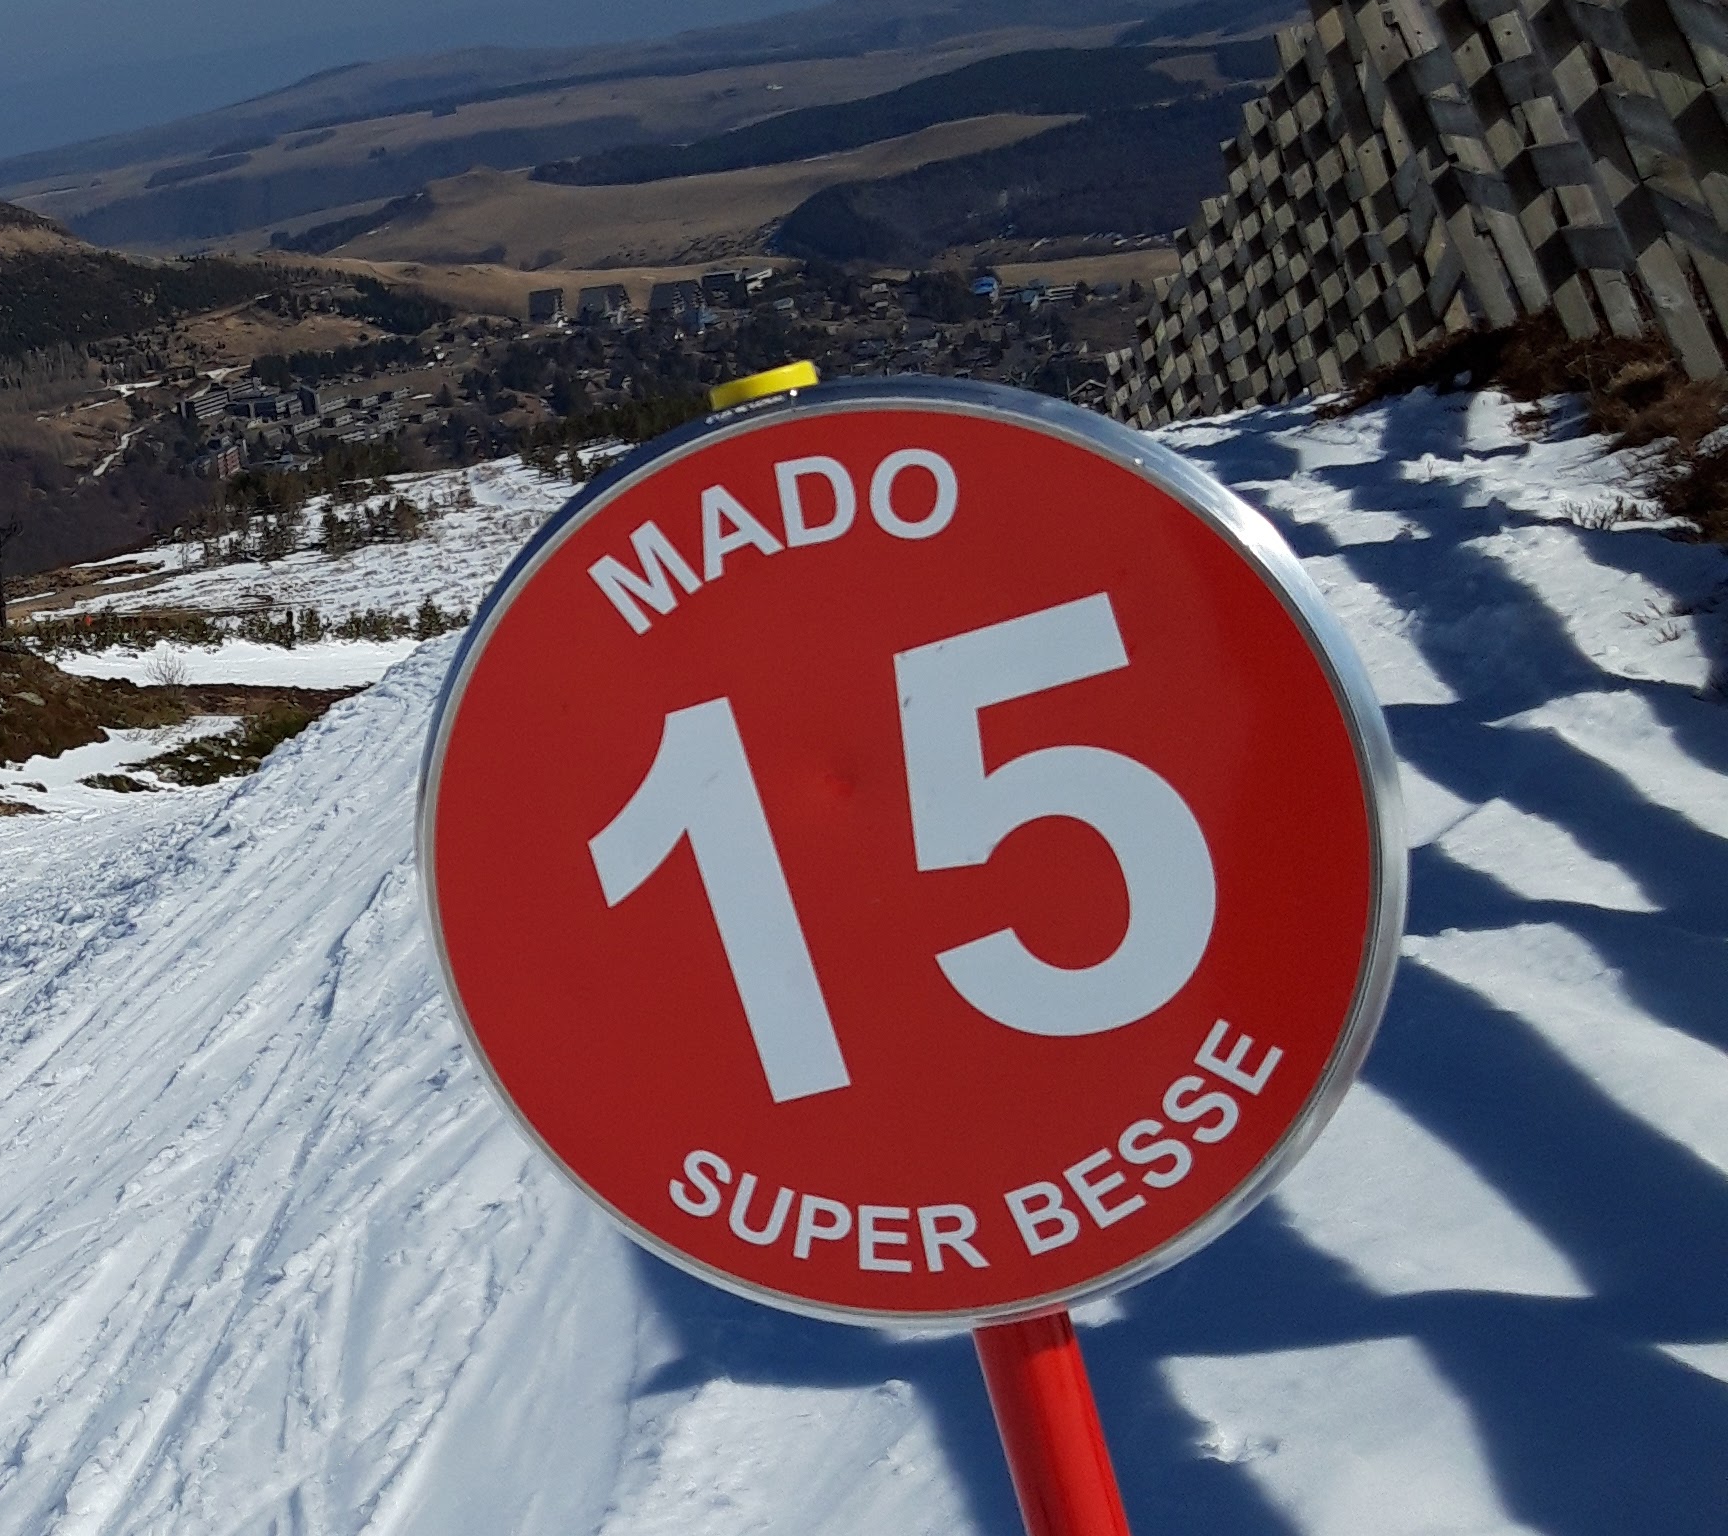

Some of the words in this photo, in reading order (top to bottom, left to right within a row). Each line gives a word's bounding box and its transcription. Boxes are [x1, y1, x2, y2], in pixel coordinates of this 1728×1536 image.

[587, 448, 958, 635] MADO
[587, 591, 1217, 1104] 15
[668, 1149, 990, 1273] SUPER
[1003, 1018, 1284, 1256] BESSE
